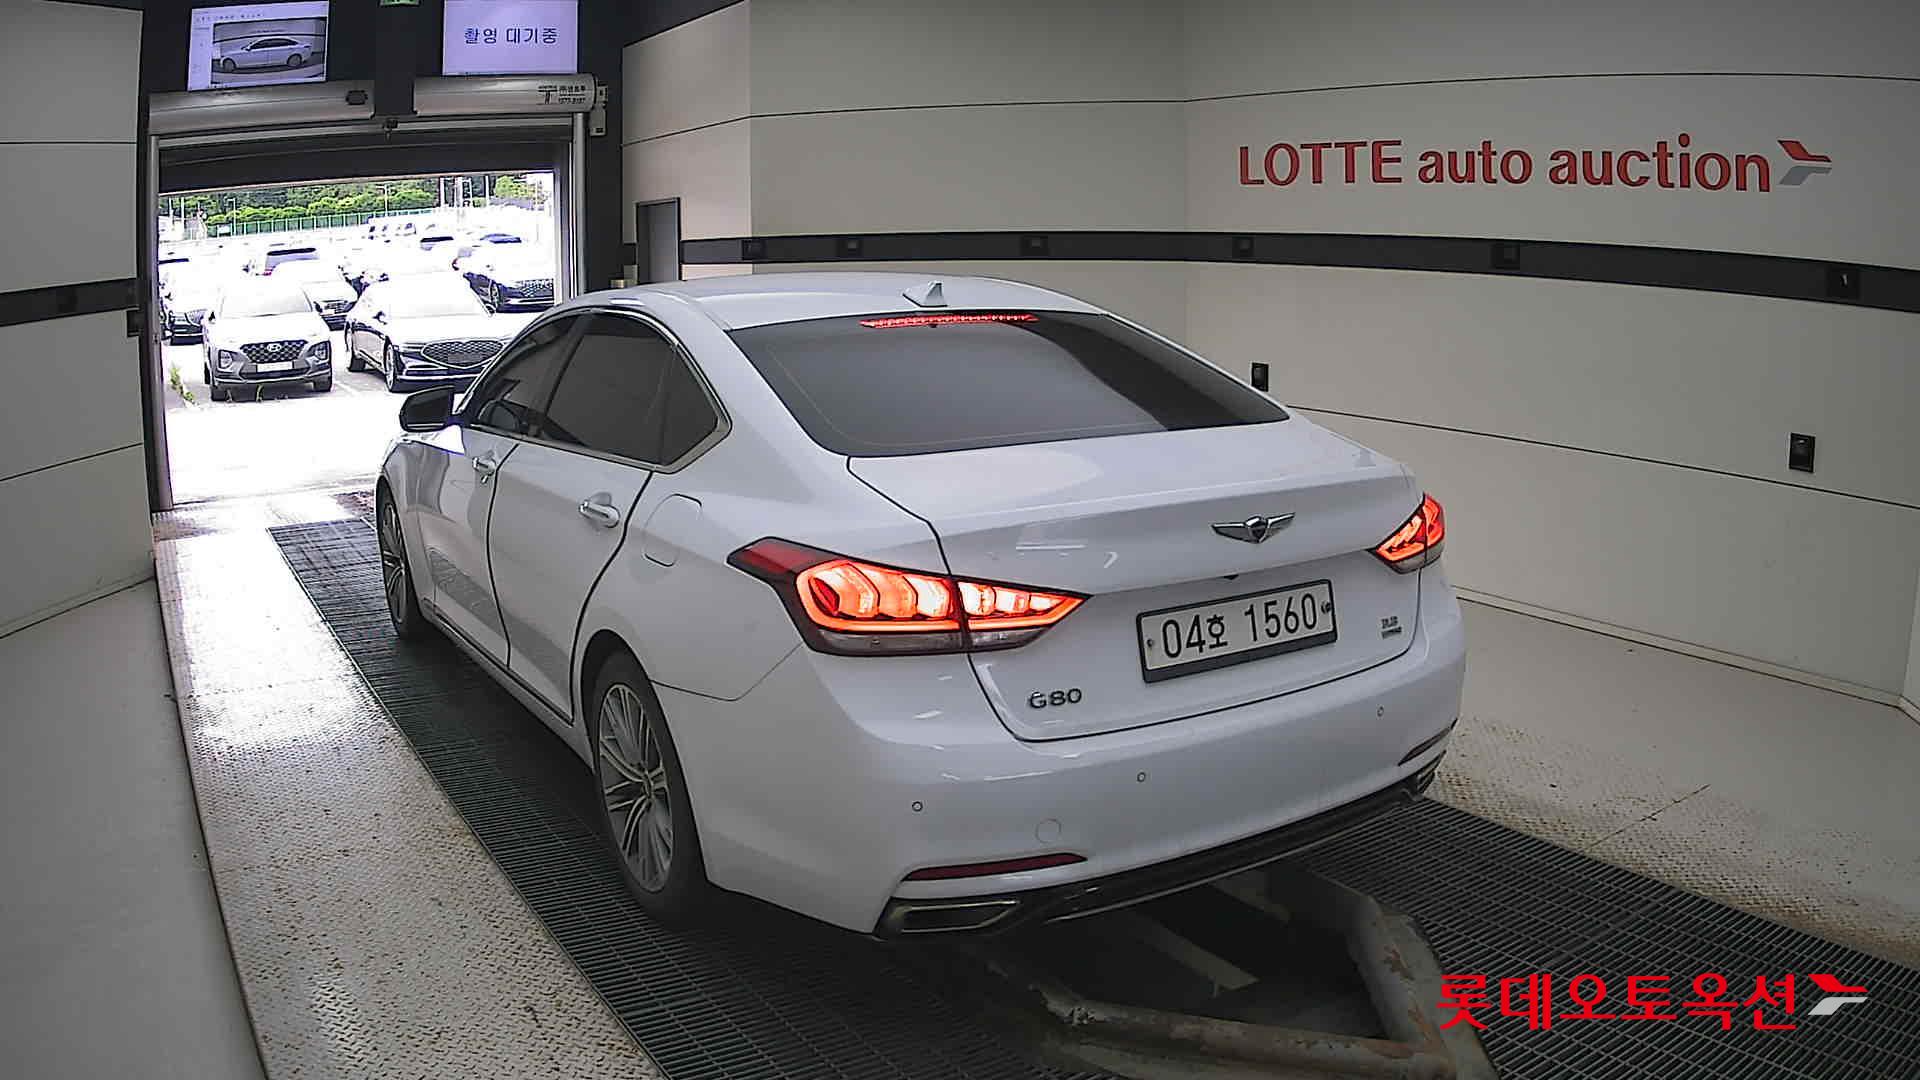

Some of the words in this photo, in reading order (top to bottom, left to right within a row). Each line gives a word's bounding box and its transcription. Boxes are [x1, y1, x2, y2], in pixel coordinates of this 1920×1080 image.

[464, 27, 497, 45] 촬영
[506, 27, 558, 45] 대기중
[1239, 139, 1403, 186] LOTTE
[1418, 139, 1533, 185] auto
[1548, 133, 1771, 193] auction
[1162, 618, 1229, 659] 04호
[1244, 592, 1318, 642] 1560
[1028, 687, 1083, 709] G80
